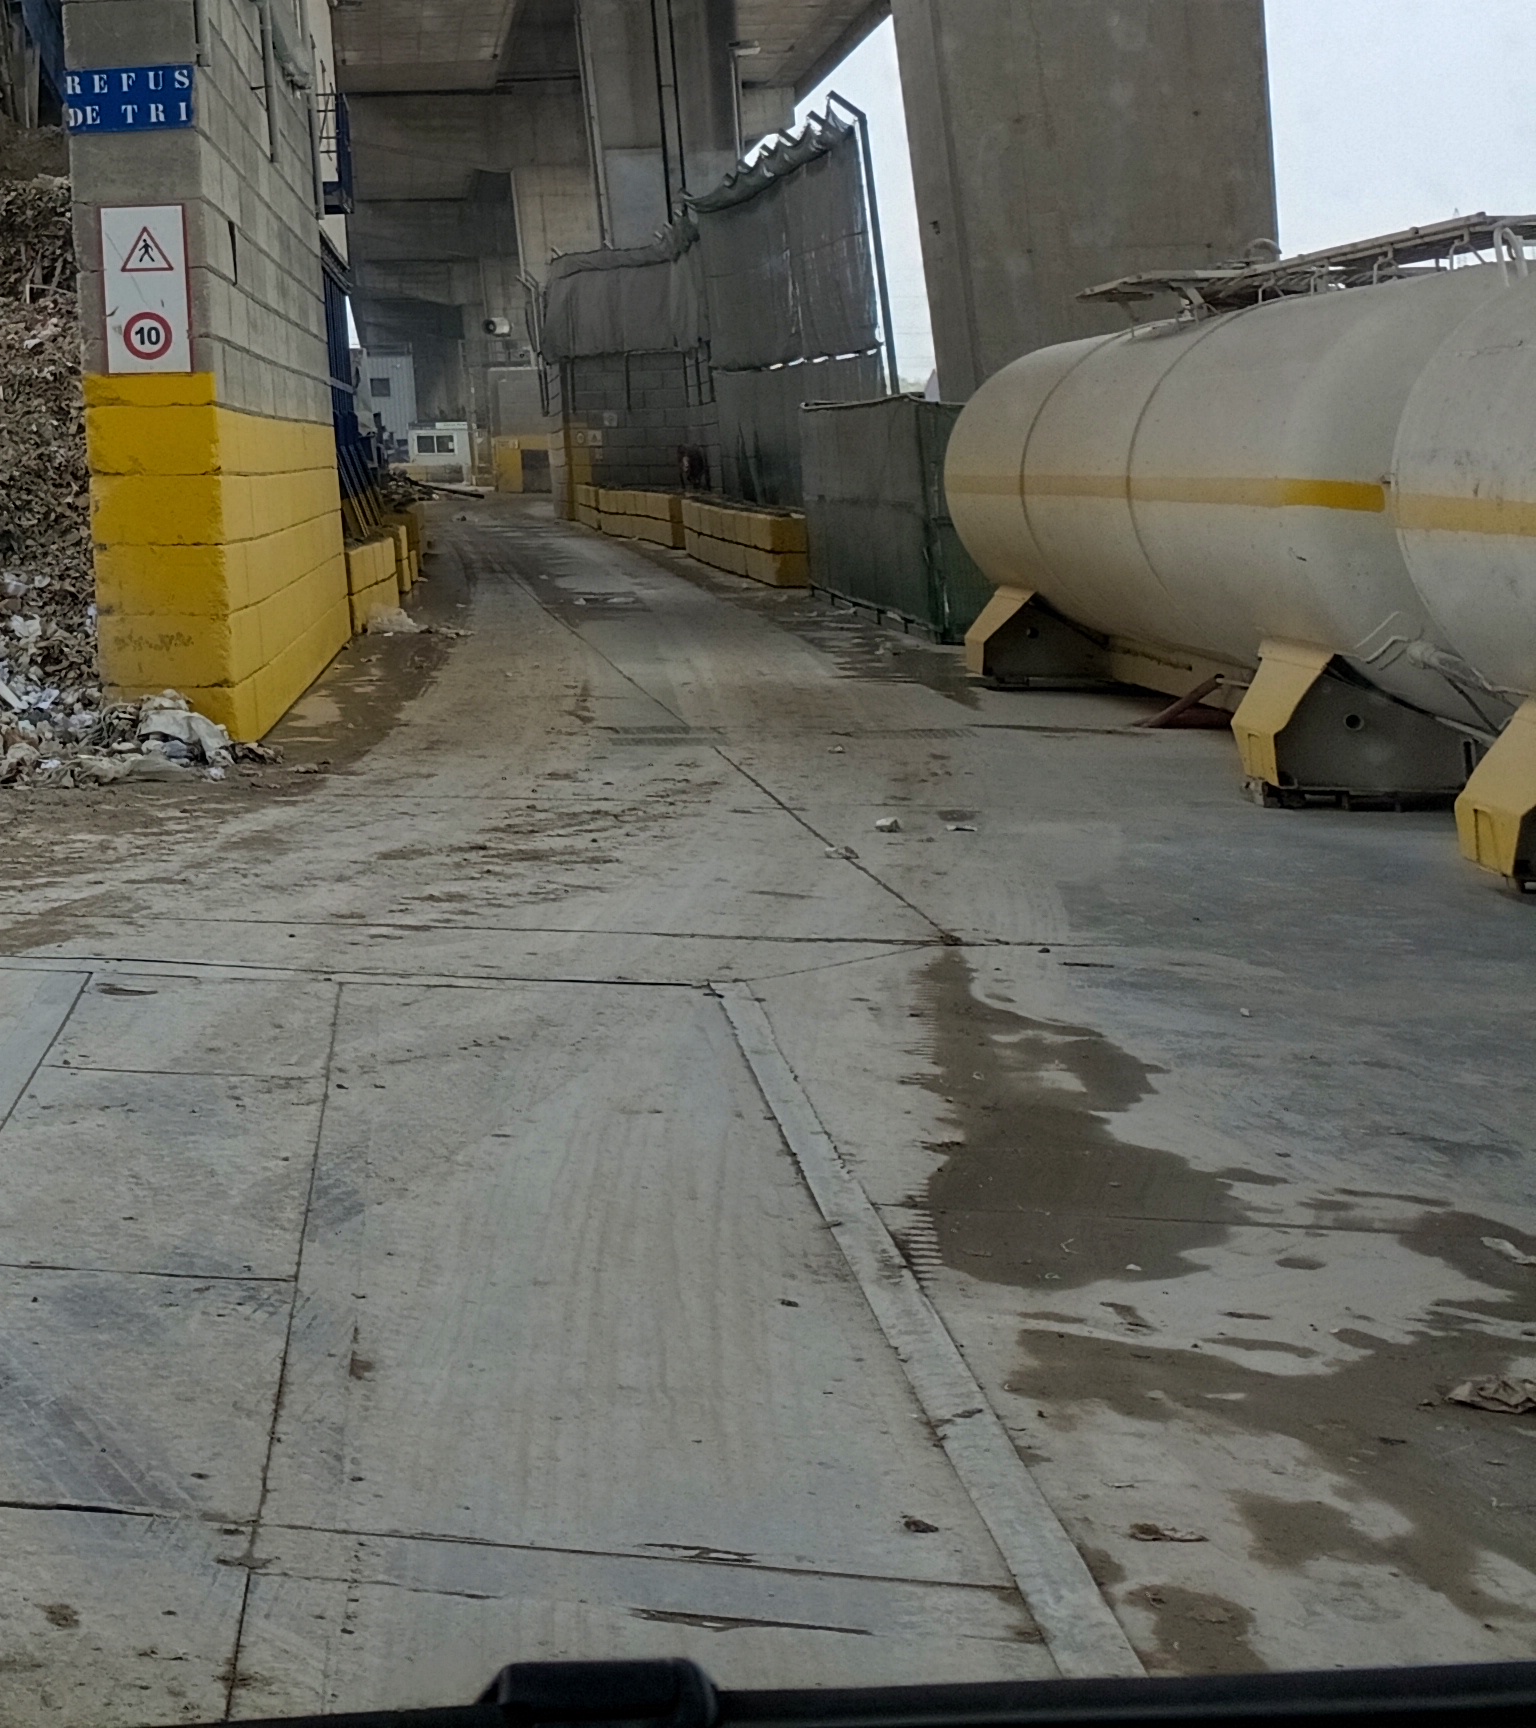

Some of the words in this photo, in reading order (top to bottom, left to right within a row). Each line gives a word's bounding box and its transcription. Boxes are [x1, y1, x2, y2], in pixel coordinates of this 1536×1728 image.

[65, 69, 190, 95] REFUS
[68, 105, 101, 127] DE
[121, 102, 188, 124] TRI
[135, 326, 161, 345] 10
